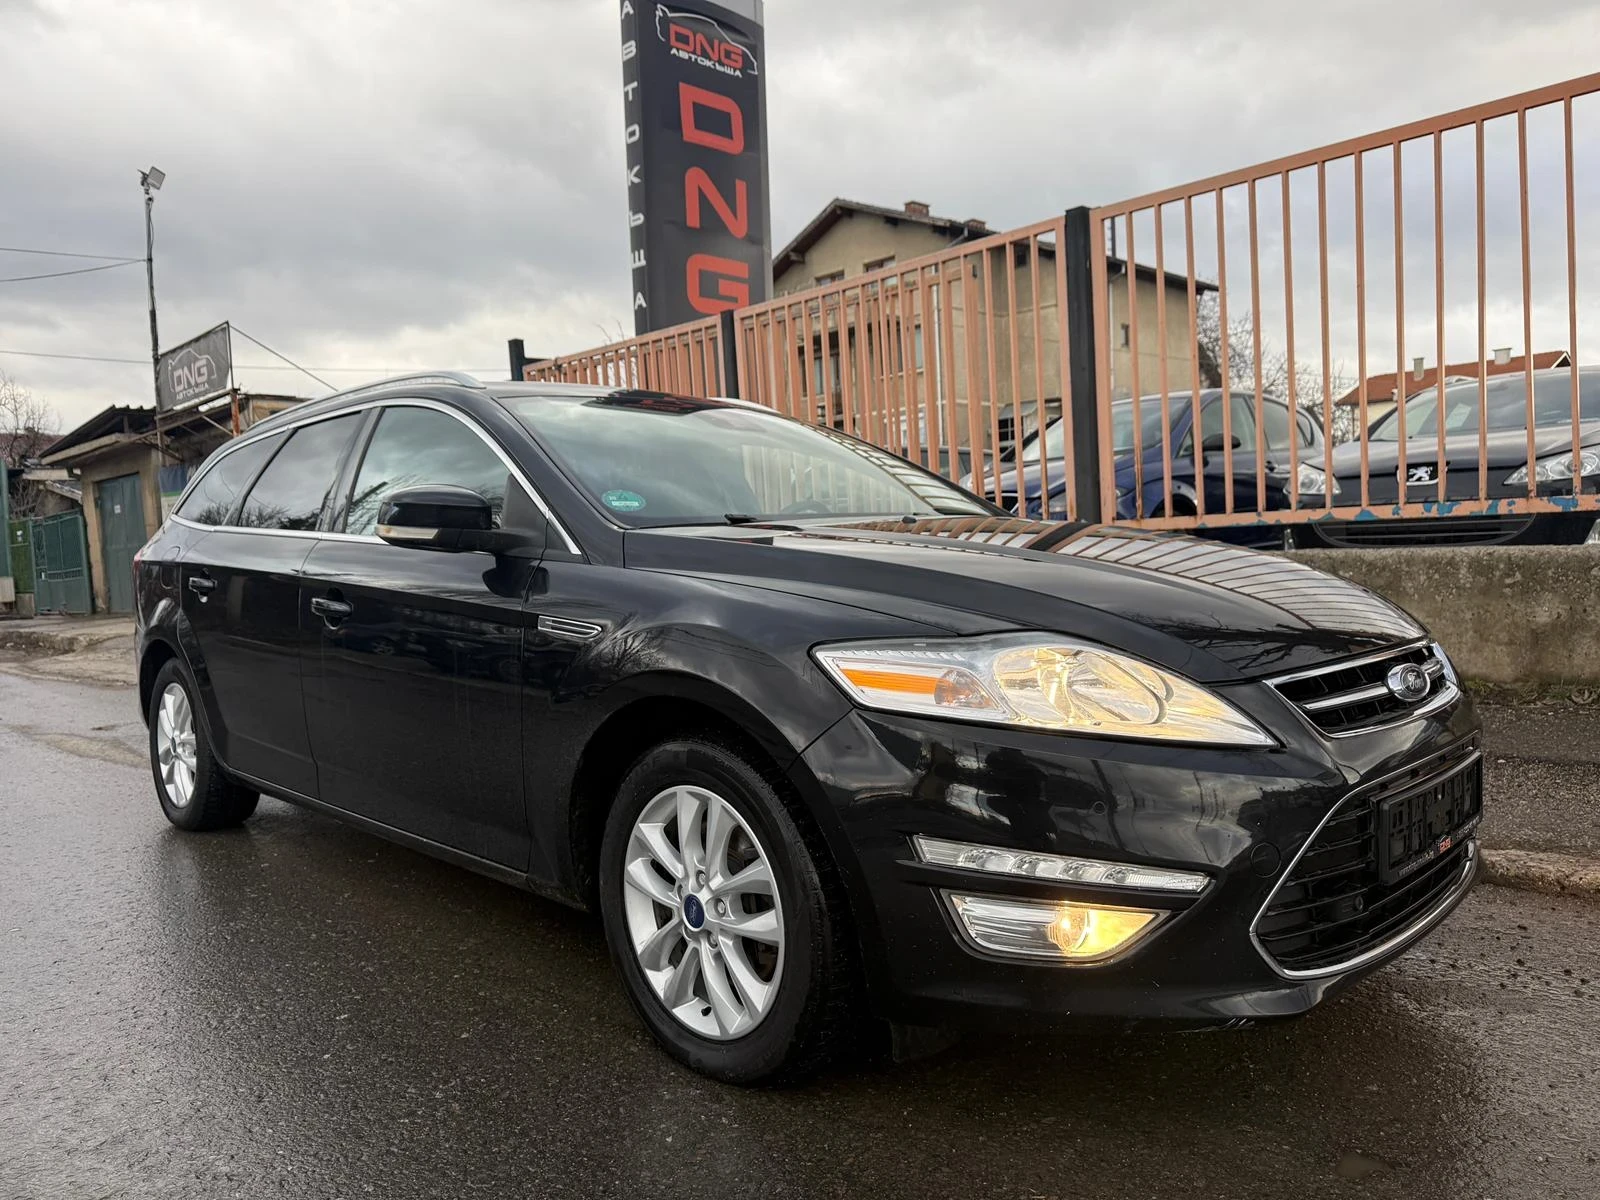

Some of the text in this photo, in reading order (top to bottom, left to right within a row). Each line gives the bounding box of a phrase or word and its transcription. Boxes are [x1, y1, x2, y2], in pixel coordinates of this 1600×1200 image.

[669, 23, 744, 69] DNG
[679, 82, 749, 315] DNG
[173, 358, 208, 393] DNG
